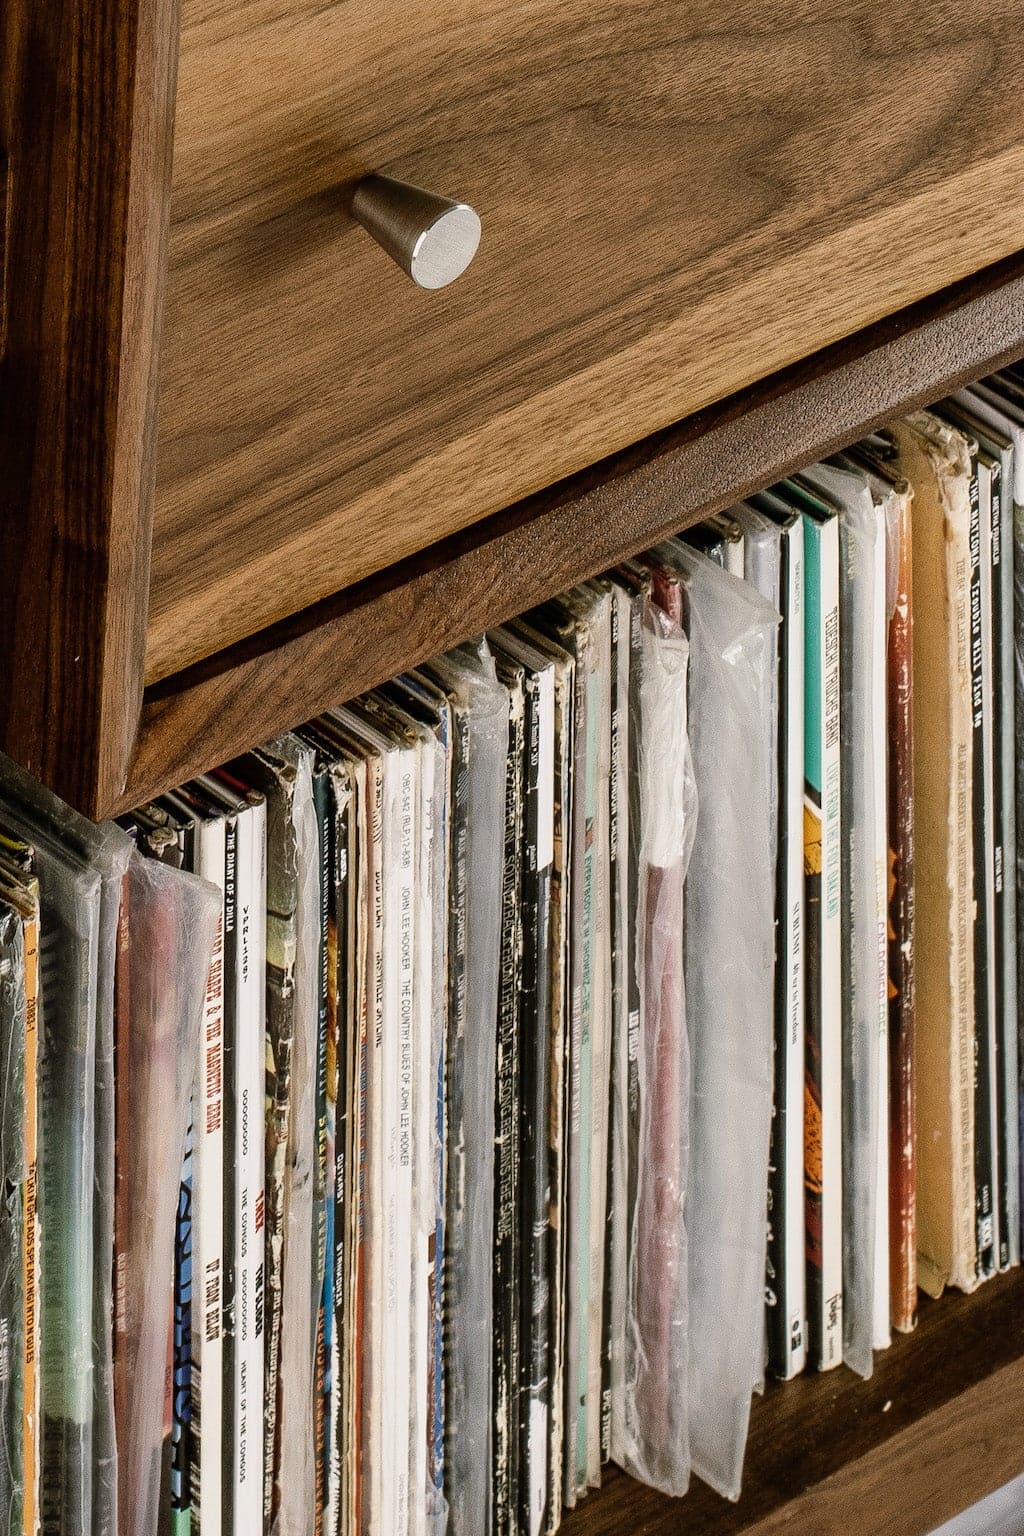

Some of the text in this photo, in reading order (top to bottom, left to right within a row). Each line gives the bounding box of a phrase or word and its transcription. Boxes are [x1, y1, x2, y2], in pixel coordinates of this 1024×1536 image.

[991, 496, 1000, 564] ARETHA FRANKLIN
[970, 480, 982, 728] THE NATIONAL Trouble Will Find Me
[825, 606, 838, 921] TEDESCHI TRUCKS BAND LIVE FROM THE FOX OAKLAND
[401, 773, 411, 812] OBC-542
[401, 815, 411, 834] (RLP
[504, 782, 515, 844] ZEPPELIN
[226, 833, 236, 852] THE
[457, 828, 467, 853] PAUL
[226, 853, 236, 880] DIARY
[375, 871, 383, 895] BOB
[456, 858, 466, 894] SIMON
[225, 883, 235, 896] OF
[401, 886, 411, 911] JOHN
[456, 895, 465, 907] IN
[502, 857, 514, 946] SOUNDTRACK
[582, 854, 593, 924] EVERYBODY'S
[225, 906, 235, 932] DILLA
[375, 896, 383, 929] DYLAN
[400, 913, 411, 929] LEE
[792, 901, 800, 956] SUBLIME
[456, 908, 465, 957] CONCERT
[400, 932, 411, 971] HOOKER
[502, 948, 514, 984] FROM
[400, 979, 411, 997] THE
[501, 987, 513, 1013] THE
[375, 1007, 383, 1049] SKYLINE
[400, 1000, 411, 1041] COUNTRY
[501, 1016, 513, 1045] FILM
[791, 1003, 800, 1045] freedom
[205, 959, 223, 1134] SHARPE & THE MAGNETIC ZEROS
[319, 1008, 328, 1097] ILLINOIS
[400, 1043, 411, 1070] BLUES
[500, 1051, 512, 1073] THE
[400, 1073, 411, 1084] OF
[400, 1087, 410, 1111] JOHN
[500, 1079, 512, 1116] SONG
[400, 1113, 410, 1129] LEE
[400, 1131, 410, 1167] HOOKER
[500, 1119, 512, 1175] REMAINS
[500, 1176, 511, 1202] THE
[240, 1187, 249, 1258] THE CONGOS
[255, 1189, 264, 1234] T.REX
[335, 1153, 344, 1307] OUTKAST STANKONIA
[499, 1203, 511, 1240] SAME
[117, 1252, 126, 1270] OLD
[205, 1258, 220, 1343] UP FROM BELOW
[254, 1263, 264, 1340] THE SLIDER
[238, 1360, 248, 1484] HEART OF THE CONGOS
[602, 1389, 611, 1450] EPIC STEREO
